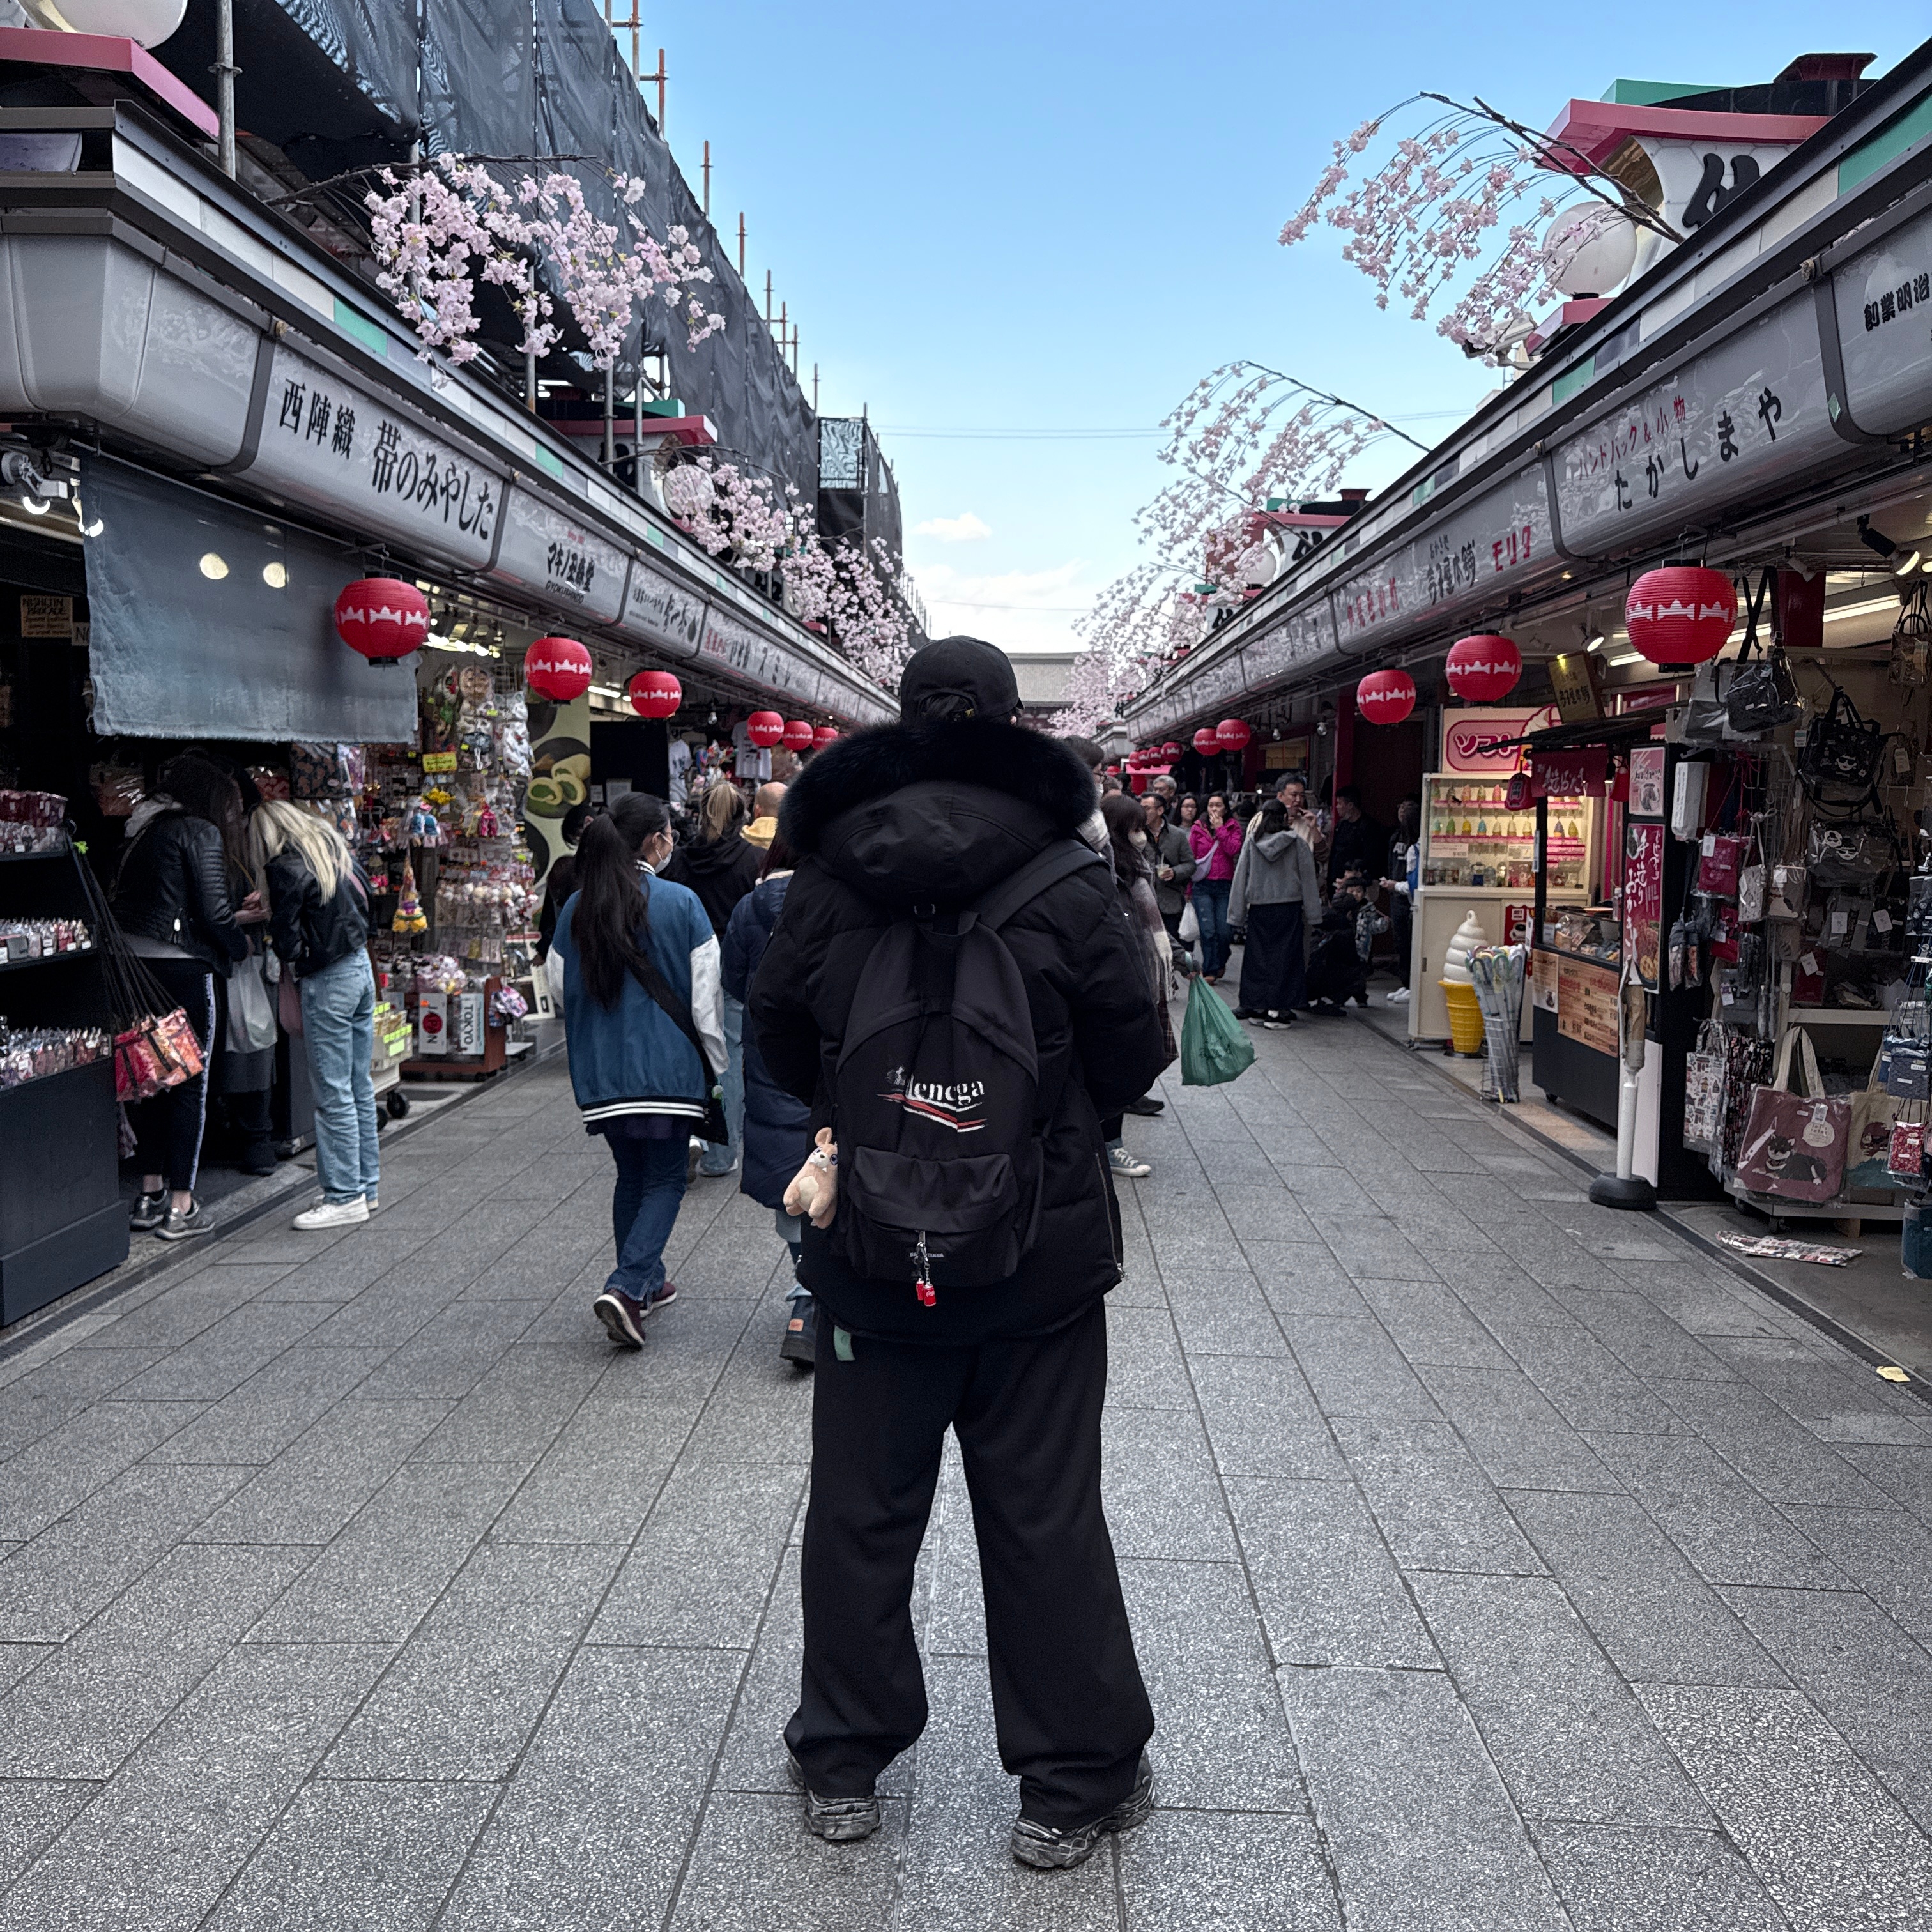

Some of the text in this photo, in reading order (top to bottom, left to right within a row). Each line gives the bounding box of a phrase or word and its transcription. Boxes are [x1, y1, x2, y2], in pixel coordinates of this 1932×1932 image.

[1864, 273, 1930, 332] 創業明治
[280, 378, 494, 540] 西陣織 帯のみやした
[1614, 387, 1782, 512] たかしまや
[1492, 525, 1531, 572] モリタ
[464, 1002, 473, 1045] TOKYO
